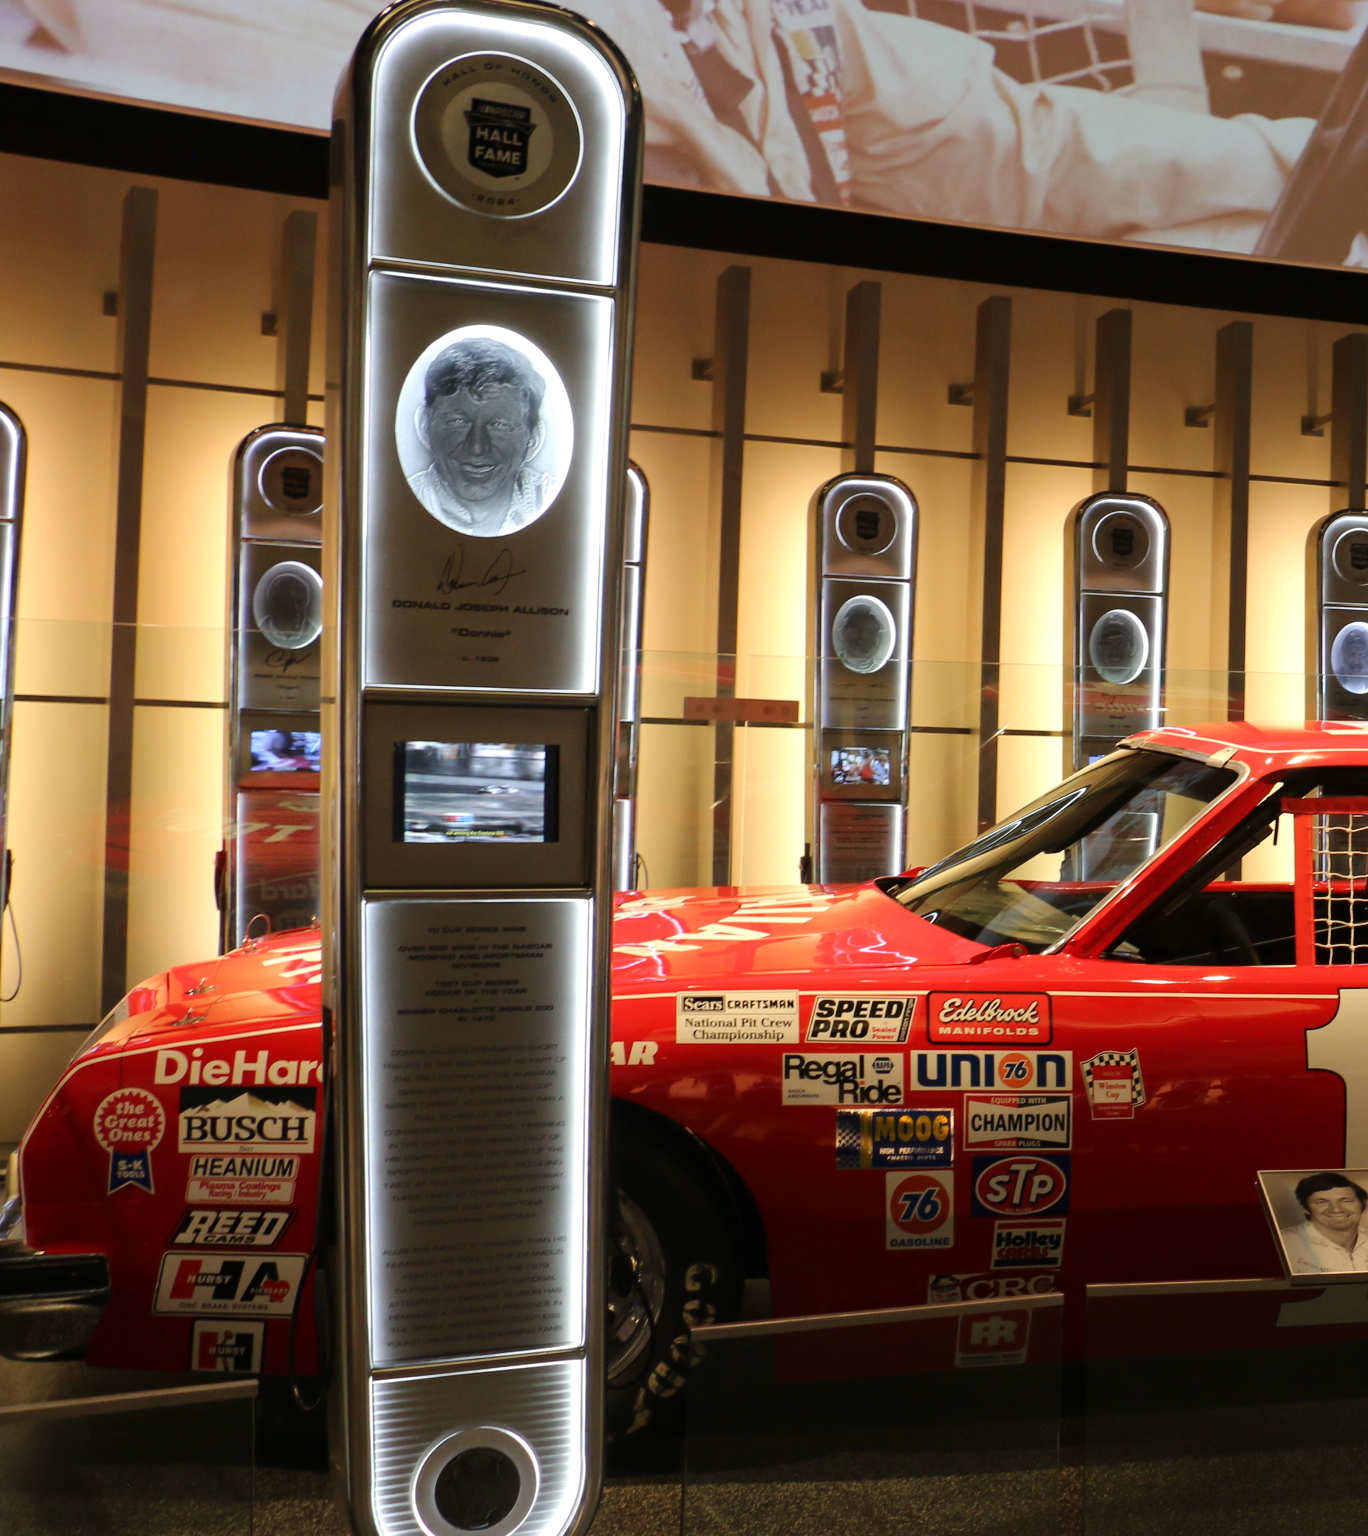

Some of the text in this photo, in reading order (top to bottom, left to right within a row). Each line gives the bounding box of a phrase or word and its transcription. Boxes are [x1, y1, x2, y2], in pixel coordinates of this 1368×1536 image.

[442, 66, 477, 86] HALL
[511, 67, 557, 103] HONOR
[476, 127, 522, 146] HALL
[475, 146, 522, 165] FAME
[392, 600, 569, 616] DONALD JOSEPH ALLISON
[397, 1008, 436, 1016] WINNER
[683, 997, 794, 1011] Sears CRAFTSMAN
[816, 1000, 904, 1018] SPEED
[938, 998, 1040, 1024] Edelbrock
[685, 1018, 793, 1028] National Pit Crew
[810, 1020, 869, 1038] PRO
[938, 1027, 1039, 1036] MANIFOLDS
[693, 1030, 784, 1042] Championship
[154, 1047, 323, 1085] DieHar
[784, 1055, 865, 1084] Regal
[1002, 1060, 1029, 1079] 76
[838, 1079, 902, 1104] Ride
[1106, 1091, 1120, 1100] Cup
[115, 1101, 145, 1114] the
[104, 1115, 155, 1128] Great
[184, 1116, 309, 1141] BUSCH
[874, 1115, 950, 1142] MOOG
[971, 1114, 1065, 1131] CHAMPION
[108, 1128, 152, 1142] Ones
[118, 1160, 143, 1170] S-K
[193, 1158, 294, 1177] HEANIUM
[200, 1181, 281, 1192] Plasma Coatings
[986, 1163, 1054, 1207] STP
[209, 1190, 267, 1199] Racing Industry
[898, 1188, 941, 1221] 76
[173, 1211, 290, 1245] REED
[203, 1235, 256, 1243] CAMS
[890, 1237, 950, 1248] GASOLINE
[996, 1232, 1061, 1250] Holley
[187, 1275, 232, 1284] HURST
[966, 1275, 1055, 1300] CRC
[209, 1347, 246, 1356] HURST
